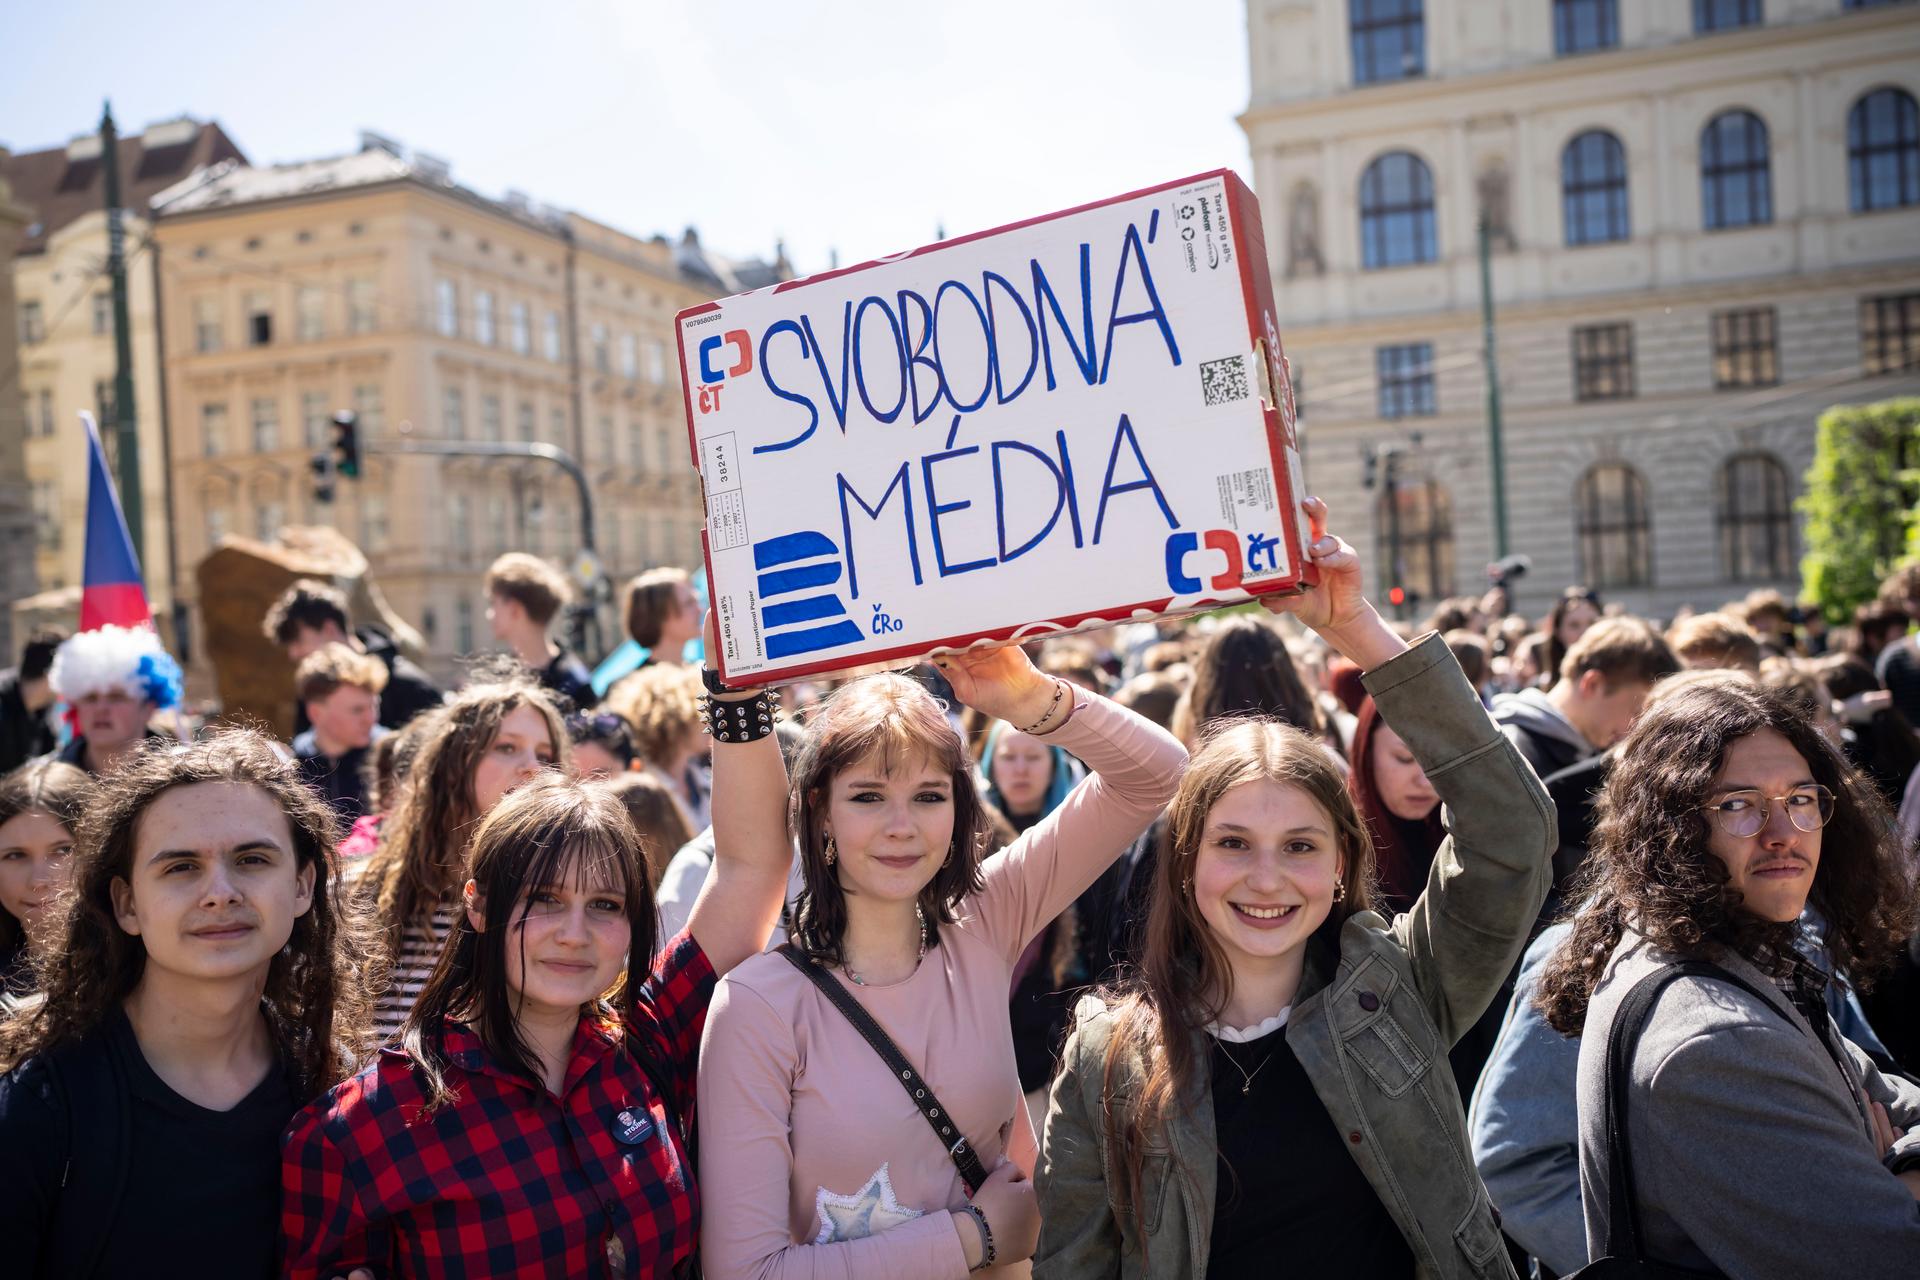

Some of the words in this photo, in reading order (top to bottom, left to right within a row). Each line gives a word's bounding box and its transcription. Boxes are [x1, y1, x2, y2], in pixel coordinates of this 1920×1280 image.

[1214, 193, 1222, 213] Tara
[1218, 215, 1226, 232] 450
[753, 209, 1182, 454] SVOBODNÁ
[697, 384, 724, 414] ČT
[715, 445, 728, 483] 38244
[836, 415, 1181, 599] MÉDIA
[1247, 533, 1279, 572] ČT
[751, 610, 762, 656] International
[872, 603, 903, 634] ČRo
